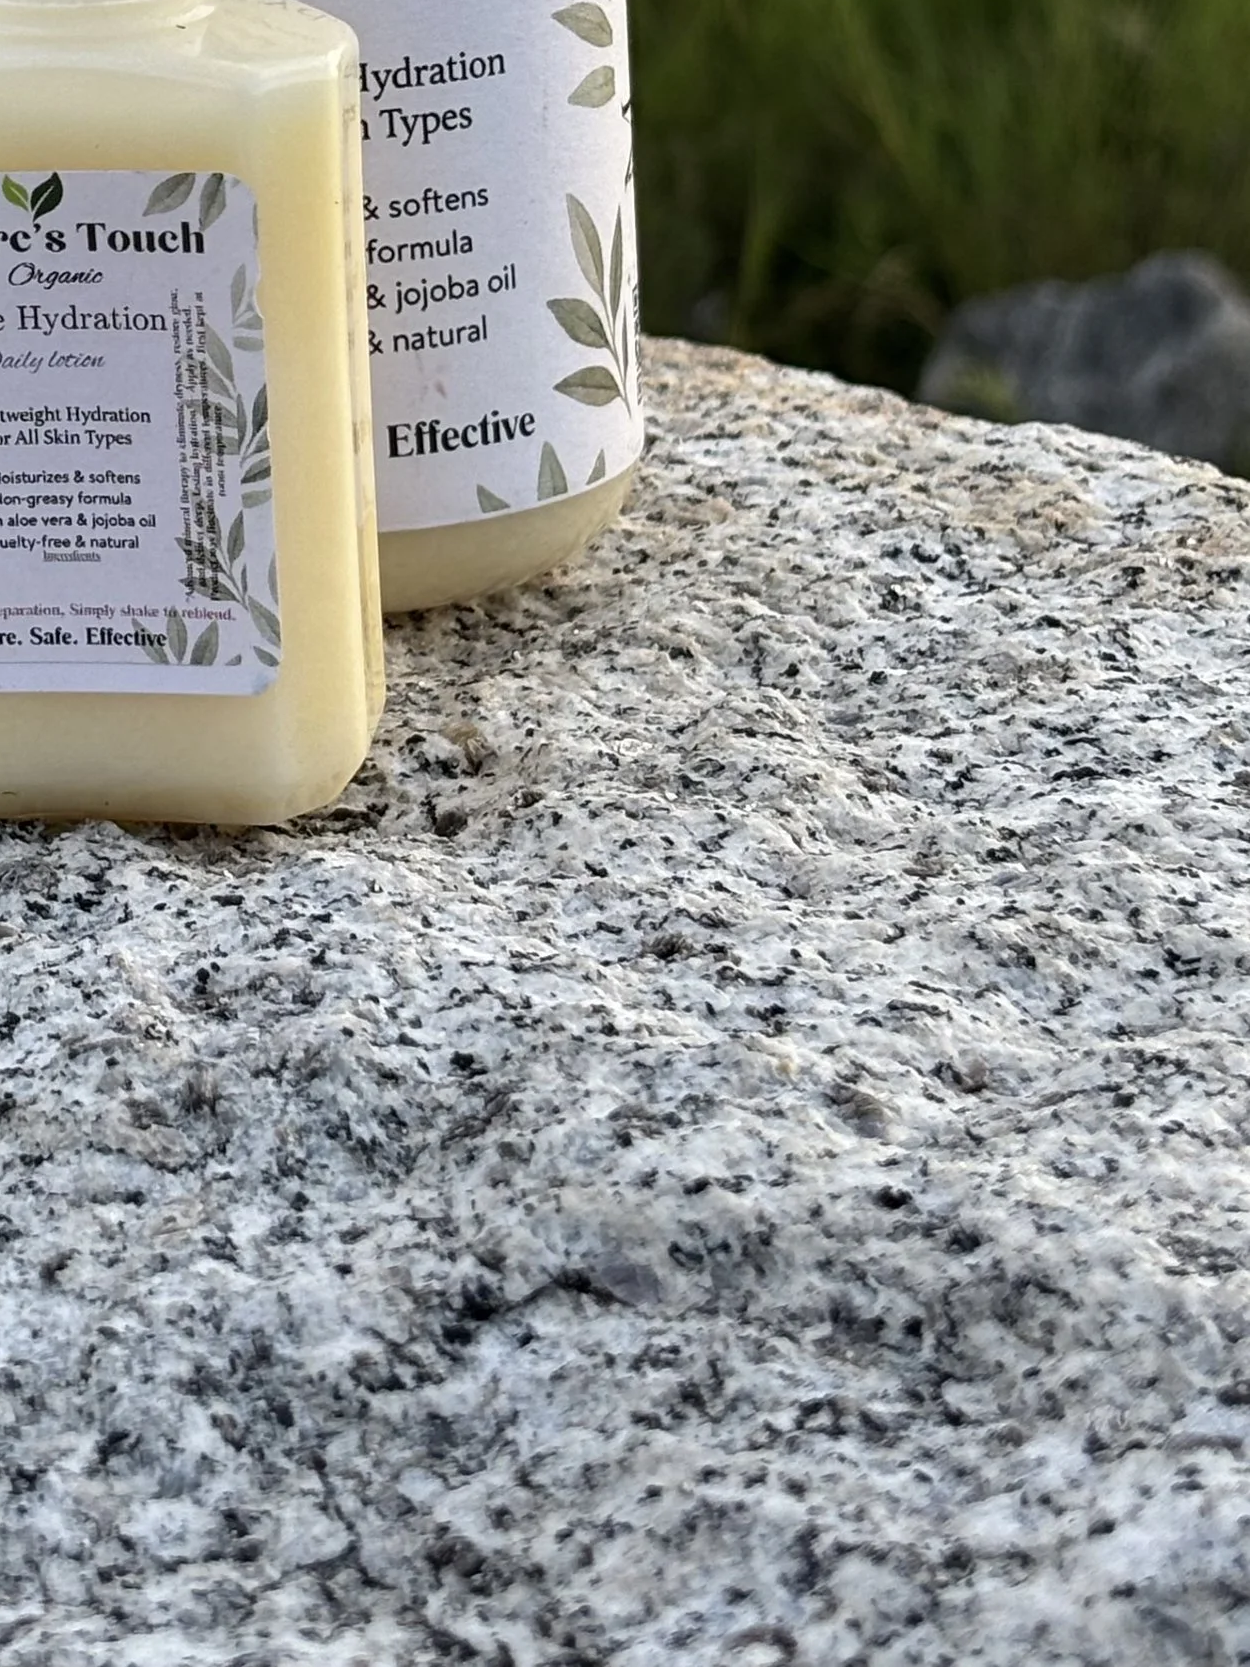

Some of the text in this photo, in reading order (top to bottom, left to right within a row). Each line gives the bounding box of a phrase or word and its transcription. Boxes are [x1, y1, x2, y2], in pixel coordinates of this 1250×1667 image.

[378, 106, 473, 147] Types
[388, 187, 489, 219] softens
[76, 221, 205, 254] Touch
[365, 228, 473, 265] formula
[8, 262, 104, 290] Organic
[366, 262, 517, 315] & jojoba oil
[16, 304, 169, 336] Hydration
[392, 314, 488, 353] natural
[47, 350, 106, 368] lotion
[66, 405, 151, 426] Hydration
[14, 429, 39, 446] All
[43, 429, 81, 446] Skin
[84, 429, 133, 450] Types
[386, 409, 537, 460] Effective
[73, 470, 84, 484] &
[88, 470, 141, 484] softens
[78, 491, 132, 505] formula
[7, 513, 38, 527] aloe
[41, 515, 73, 527] vera
[76, 513, 88, 527] &
[92, 513, 136, 530] jojoba
[139, 514, 157, 528] oil
[75, 535, 86, 548] &
[90, 535, 139, 548] natural
[69, 603, 116, 620] Simply
[120, 605, 158, 618] shake
[181, 607, 236, 622] reblend.
[29, 626, 78, 646] Safe.
[85, 626, 169, 648] Effective
